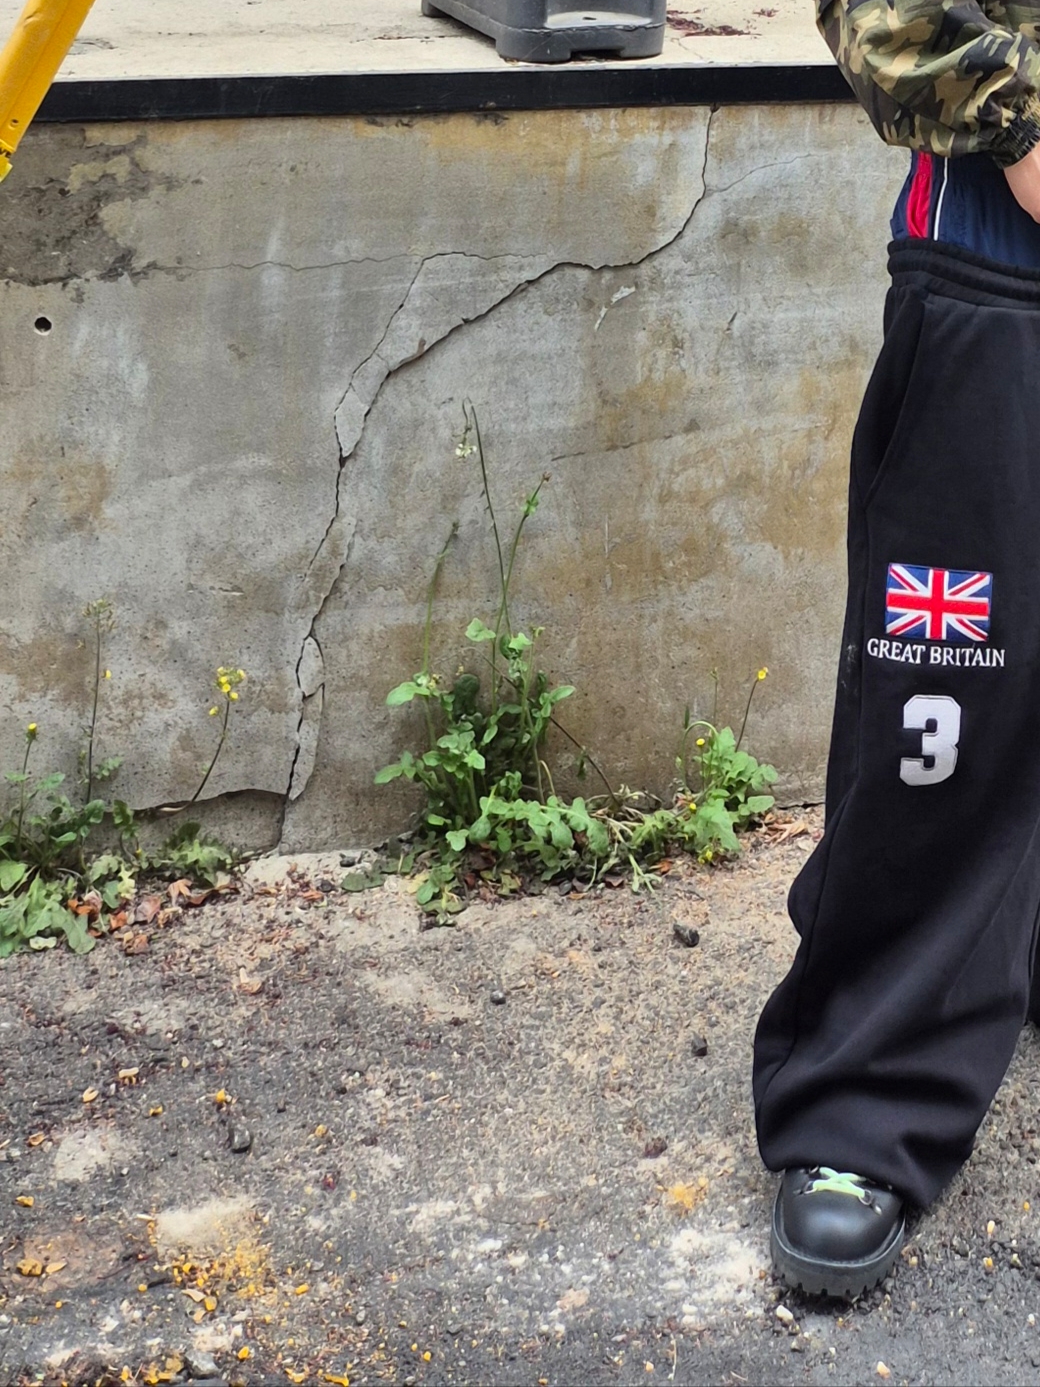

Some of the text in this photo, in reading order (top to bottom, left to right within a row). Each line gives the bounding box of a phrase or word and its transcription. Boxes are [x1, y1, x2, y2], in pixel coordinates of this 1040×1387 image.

[867, 638, 1006, 667] GREAT BRITAIN
[899, 694, 962, 787] 3
